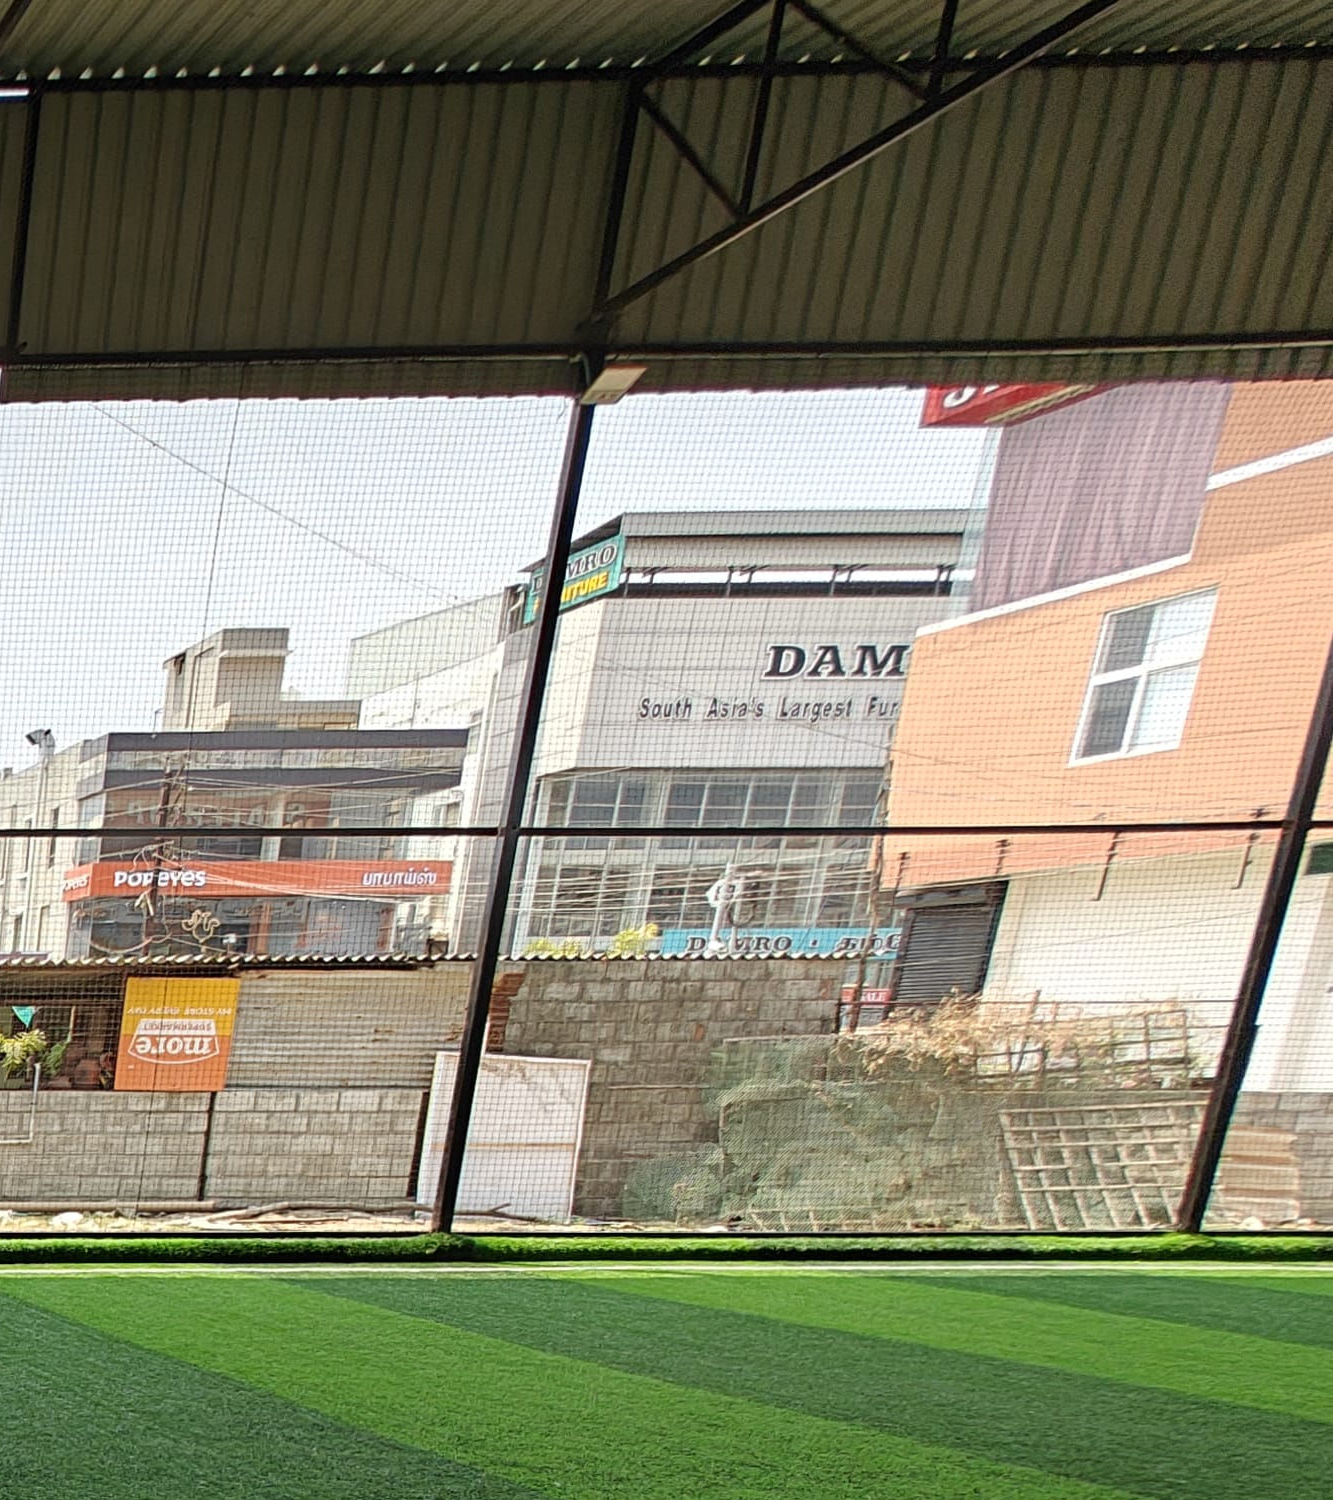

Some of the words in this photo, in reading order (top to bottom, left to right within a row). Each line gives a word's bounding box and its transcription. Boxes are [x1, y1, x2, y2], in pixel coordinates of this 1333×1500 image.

[638, 697, 692, 719] South
[706, 697, 764, 719] Asia's
[778, 697, 851, 722] Largest
[114, 870, 207, 888] POPEYES
[687, 936, 792, 951] DMRO
[183, 1007, 214, 1015] STORE
[216, 1008, 232, 1016] MY
[143, 1022, 212, 1031] SUPERMARKET
[135, 1036, 213, 1055] more
